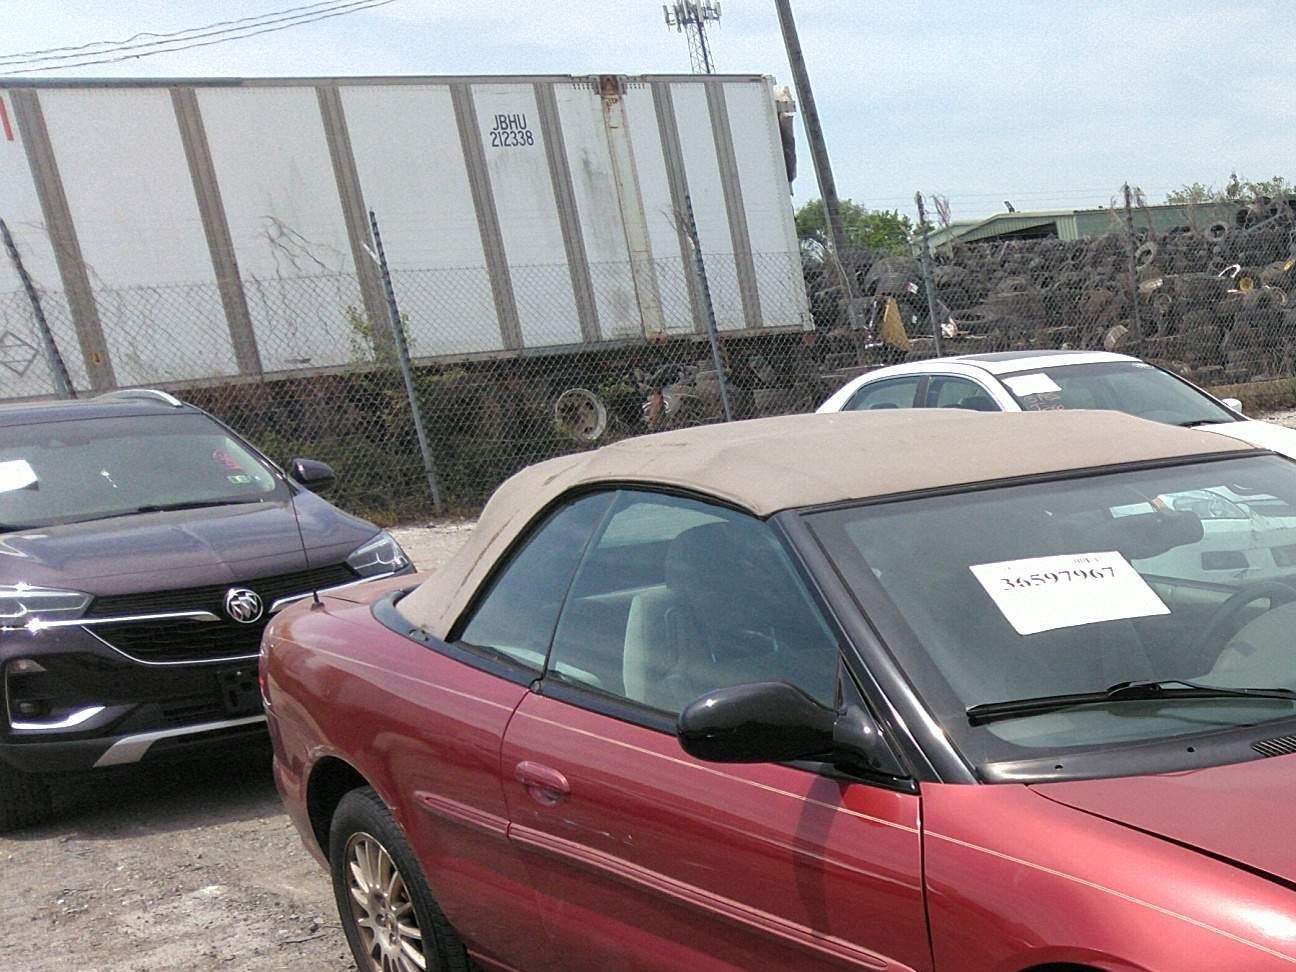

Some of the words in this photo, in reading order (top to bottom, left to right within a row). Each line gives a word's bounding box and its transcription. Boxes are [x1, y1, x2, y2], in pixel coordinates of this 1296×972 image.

[493, 114, 527, 131] JBHU
[490, 130, 534, 147] 212338
[1001, 566, 1115, 591] 36597967
